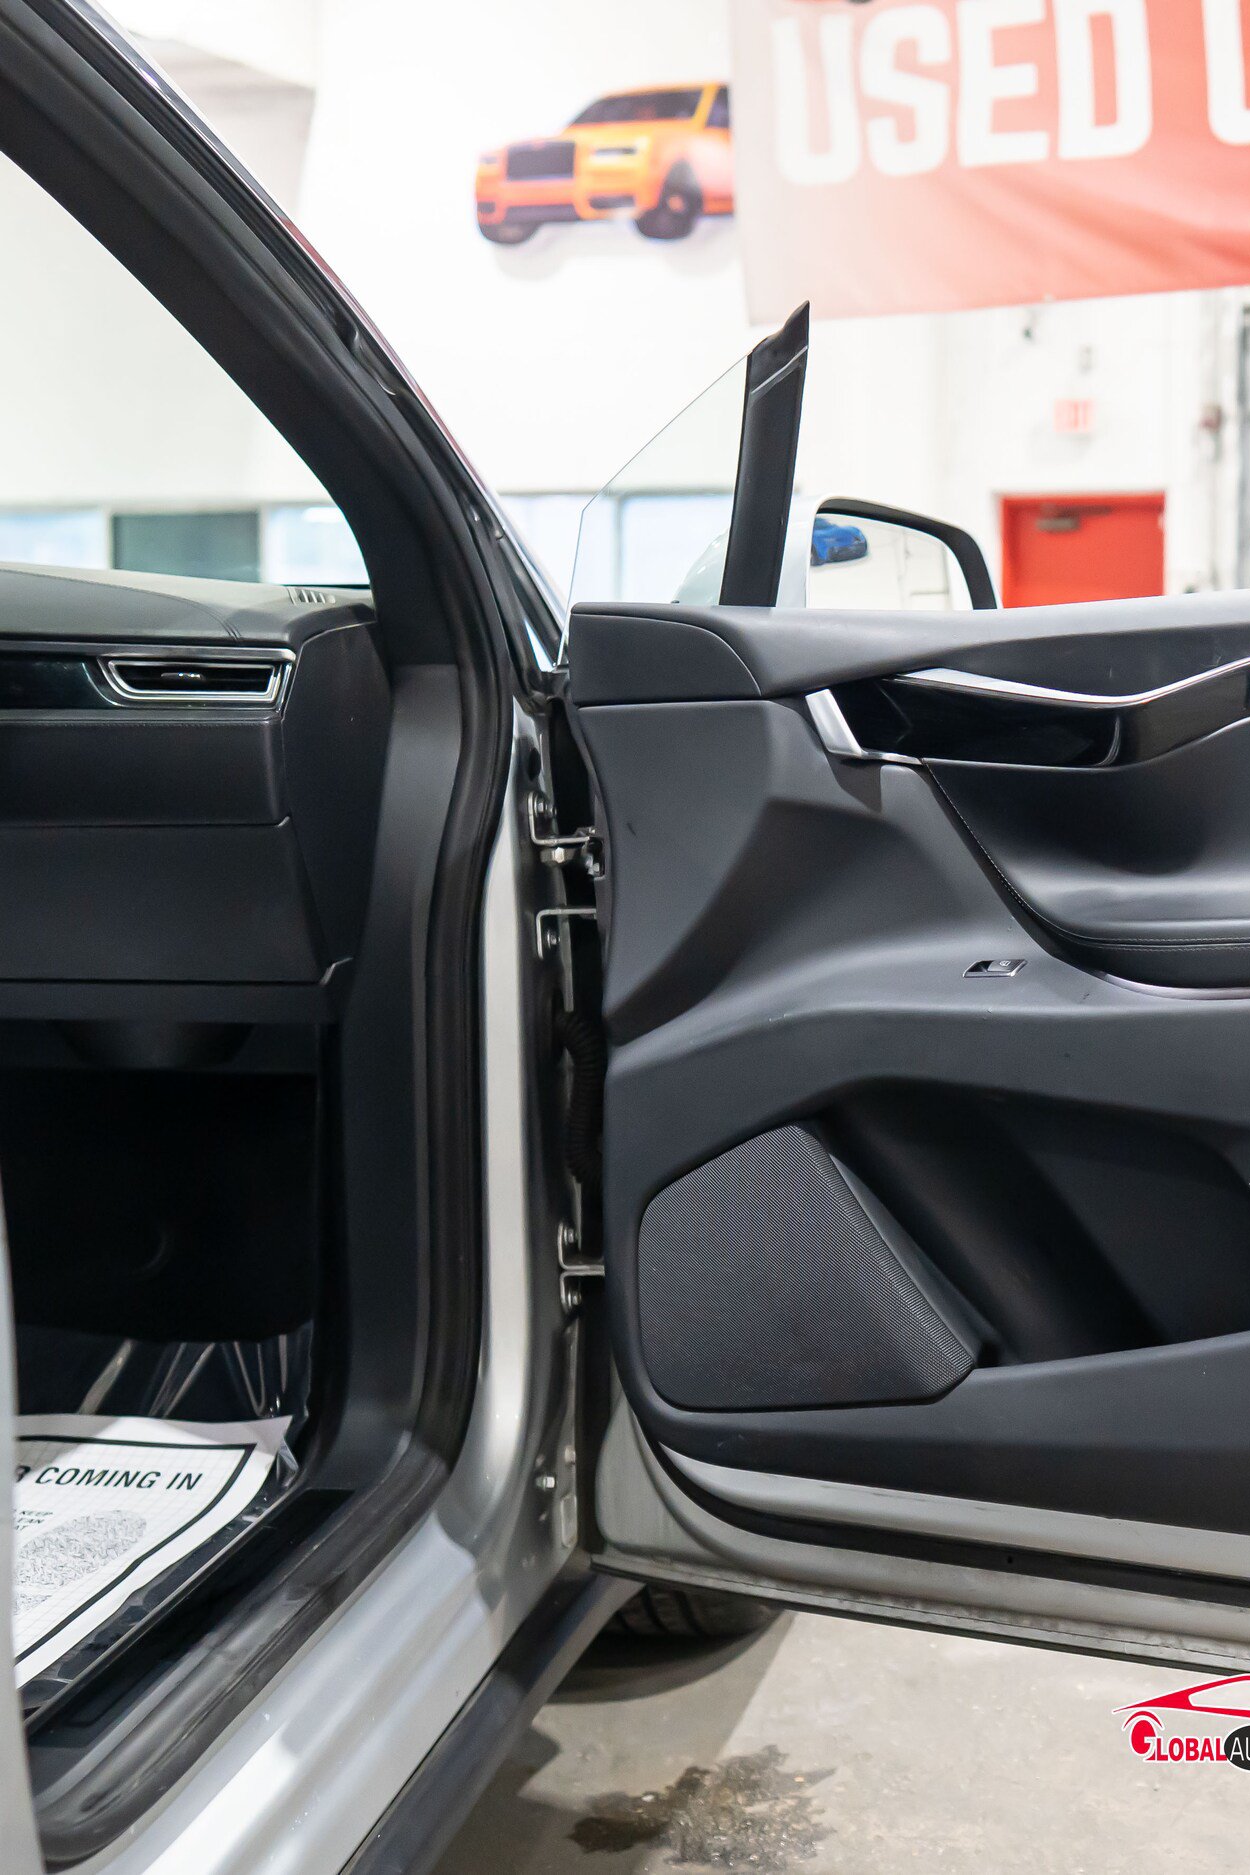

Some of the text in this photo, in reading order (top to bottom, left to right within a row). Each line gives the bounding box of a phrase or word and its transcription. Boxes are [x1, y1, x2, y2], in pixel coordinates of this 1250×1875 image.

[771, 0, 1153, 186] USED
[35, 1466, 161, 1489] COMING
[166, 1472, 203, 1490] IN
